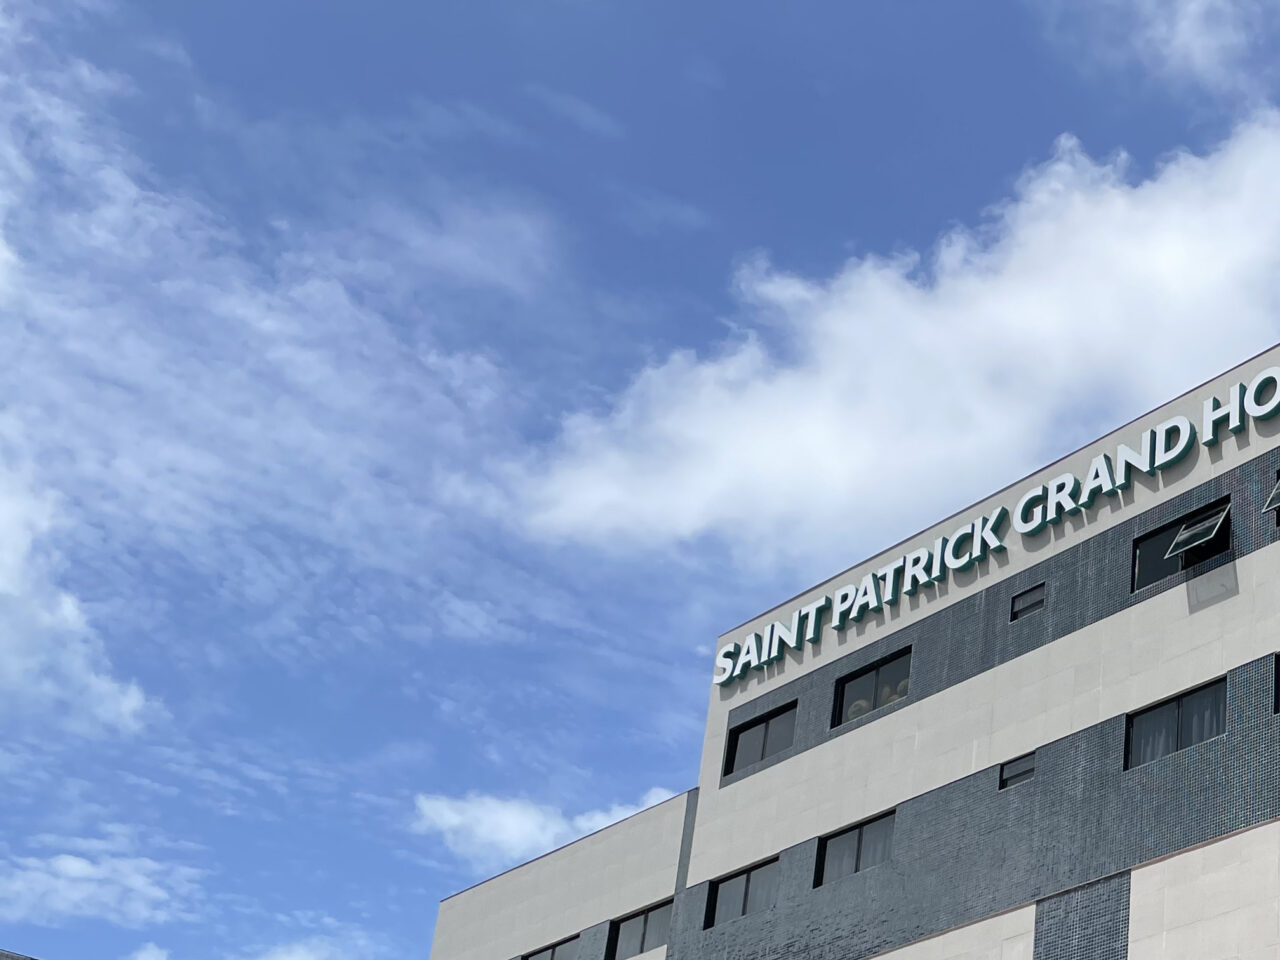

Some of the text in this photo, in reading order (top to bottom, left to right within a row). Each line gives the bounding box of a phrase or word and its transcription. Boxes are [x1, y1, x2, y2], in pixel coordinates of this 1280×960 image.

[713, 594, 832, 687] SAINT
[831, 505, 1008, 631] PATRICK
[1012, 414, 1196, 537] GRAND
